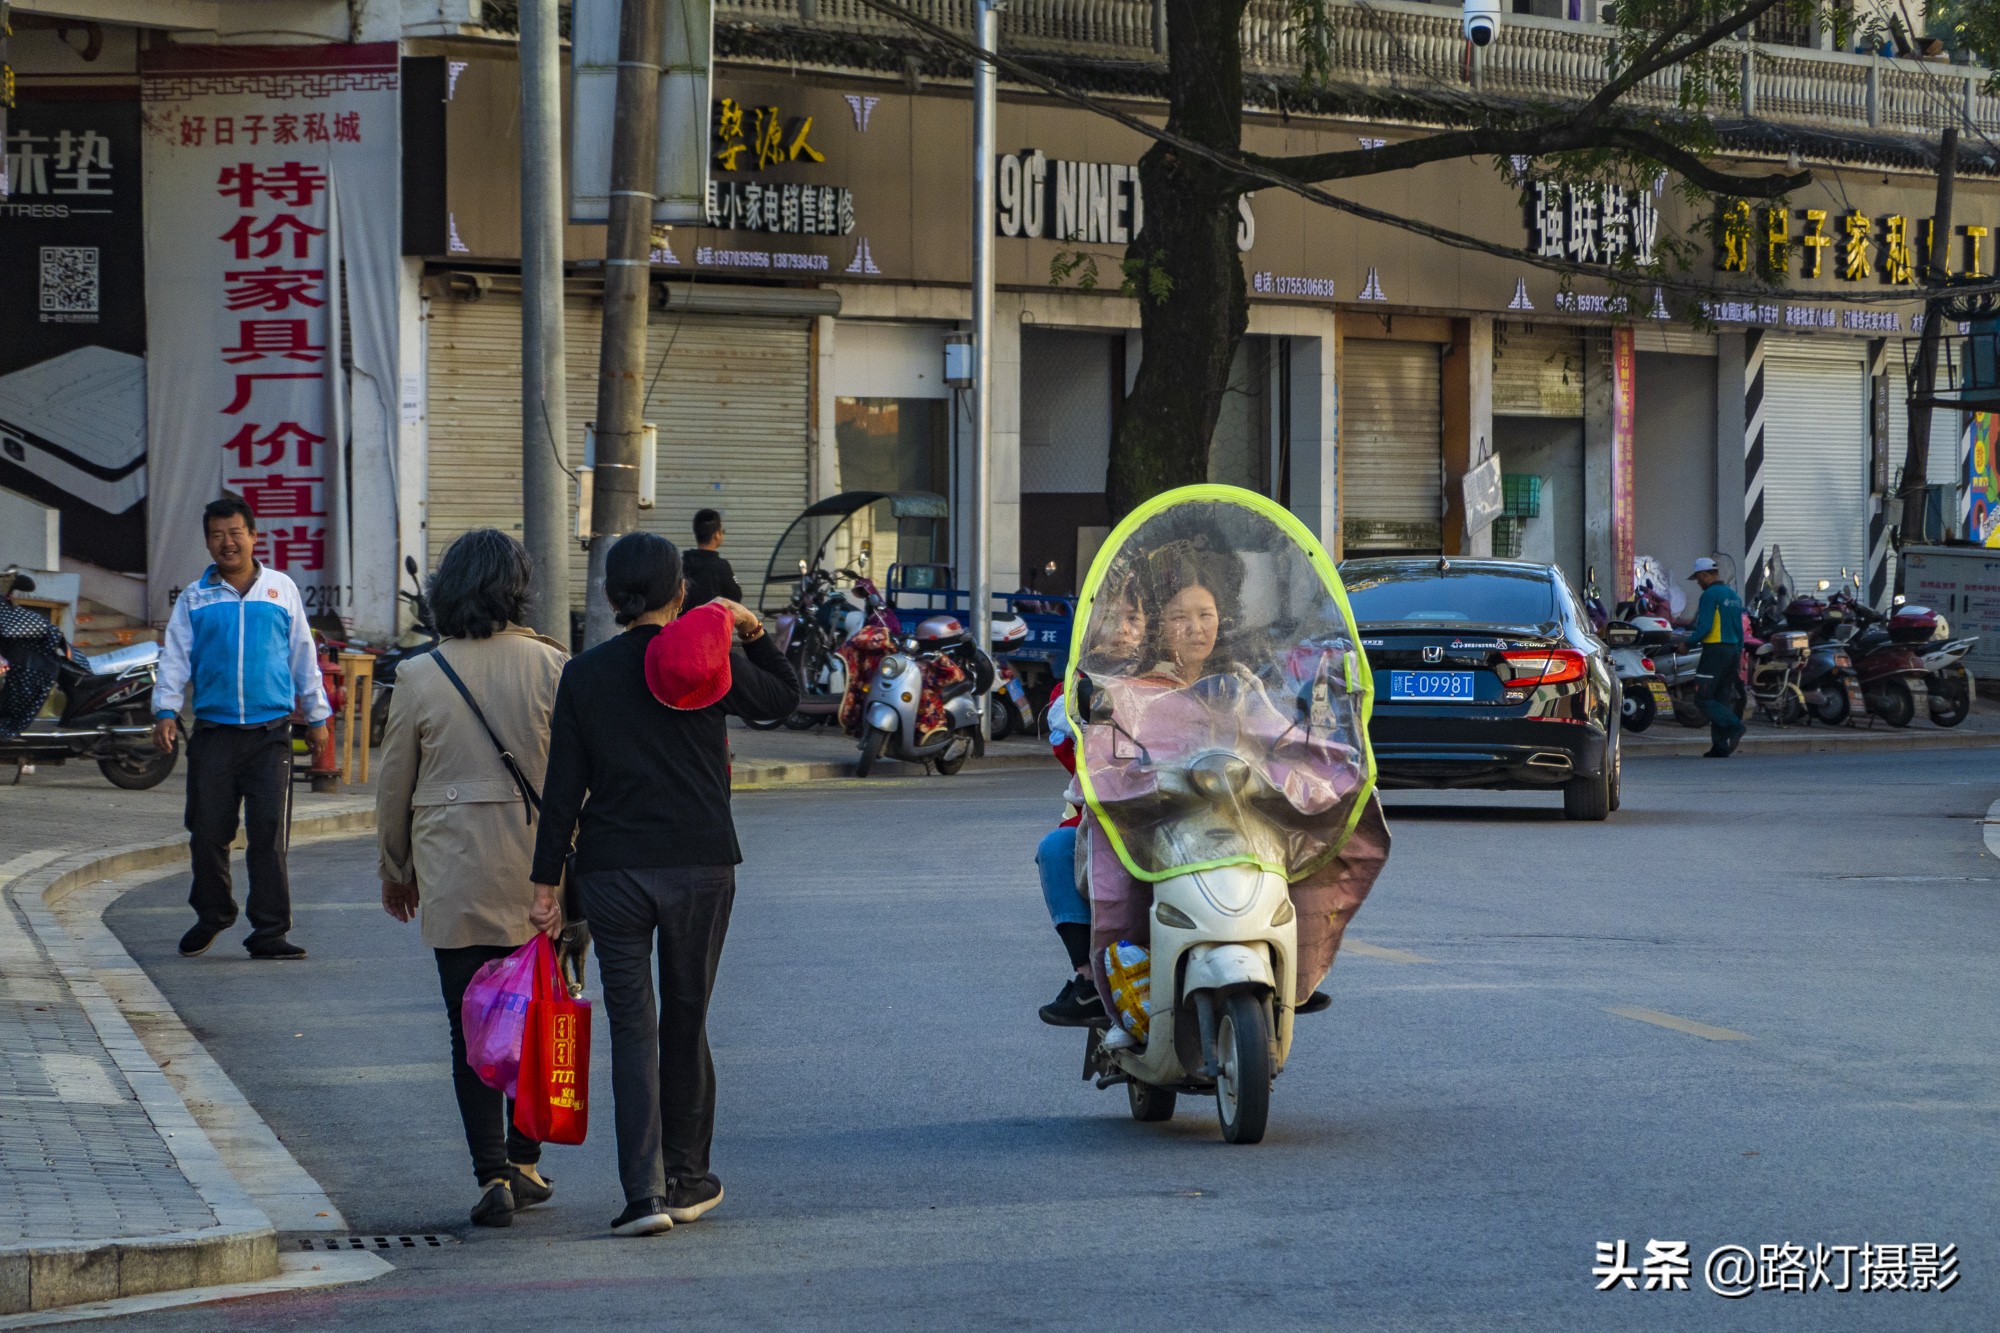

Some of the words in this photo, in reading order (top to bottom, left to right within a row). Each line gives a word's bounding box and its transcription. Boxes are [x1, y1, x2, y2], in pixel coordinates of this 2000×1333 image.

[180, 111, 361, 146] 好日子家私城
[0, 204, 69, 217] TRESS
[1723, 201, 1989, 284] 好日子家私工
[1254, 271, 1334, 296] 电话:13755306638
[217, 161, 328, 571] 特价家具厂价直销
